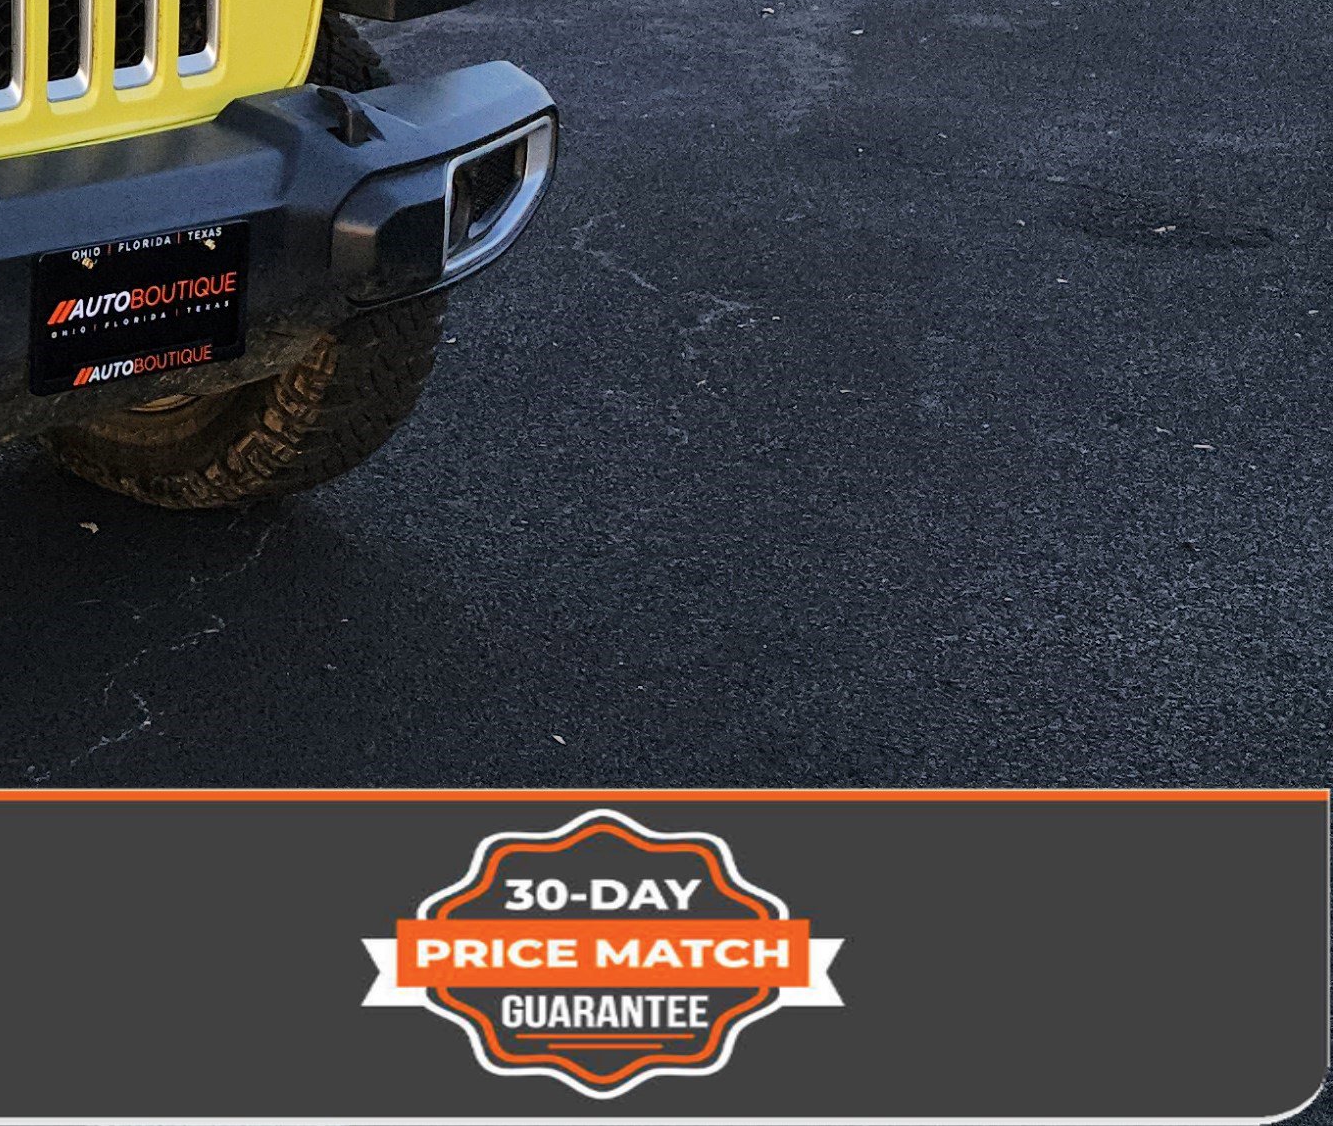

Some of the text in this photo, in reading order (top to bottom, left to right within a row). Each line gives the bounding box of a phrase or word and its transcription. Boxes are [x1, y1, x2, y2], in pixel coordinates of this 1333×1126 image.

[71, 226, 222, 261] OHIO FLORIDA TEXAS
[67, 271, 237, 322] AUTOBOUTIQUE
[51, 300, 230, 339] OHIO FLORIDA TEXAS
[88, 344, 213, 383] AUTOBOUTIQUE
